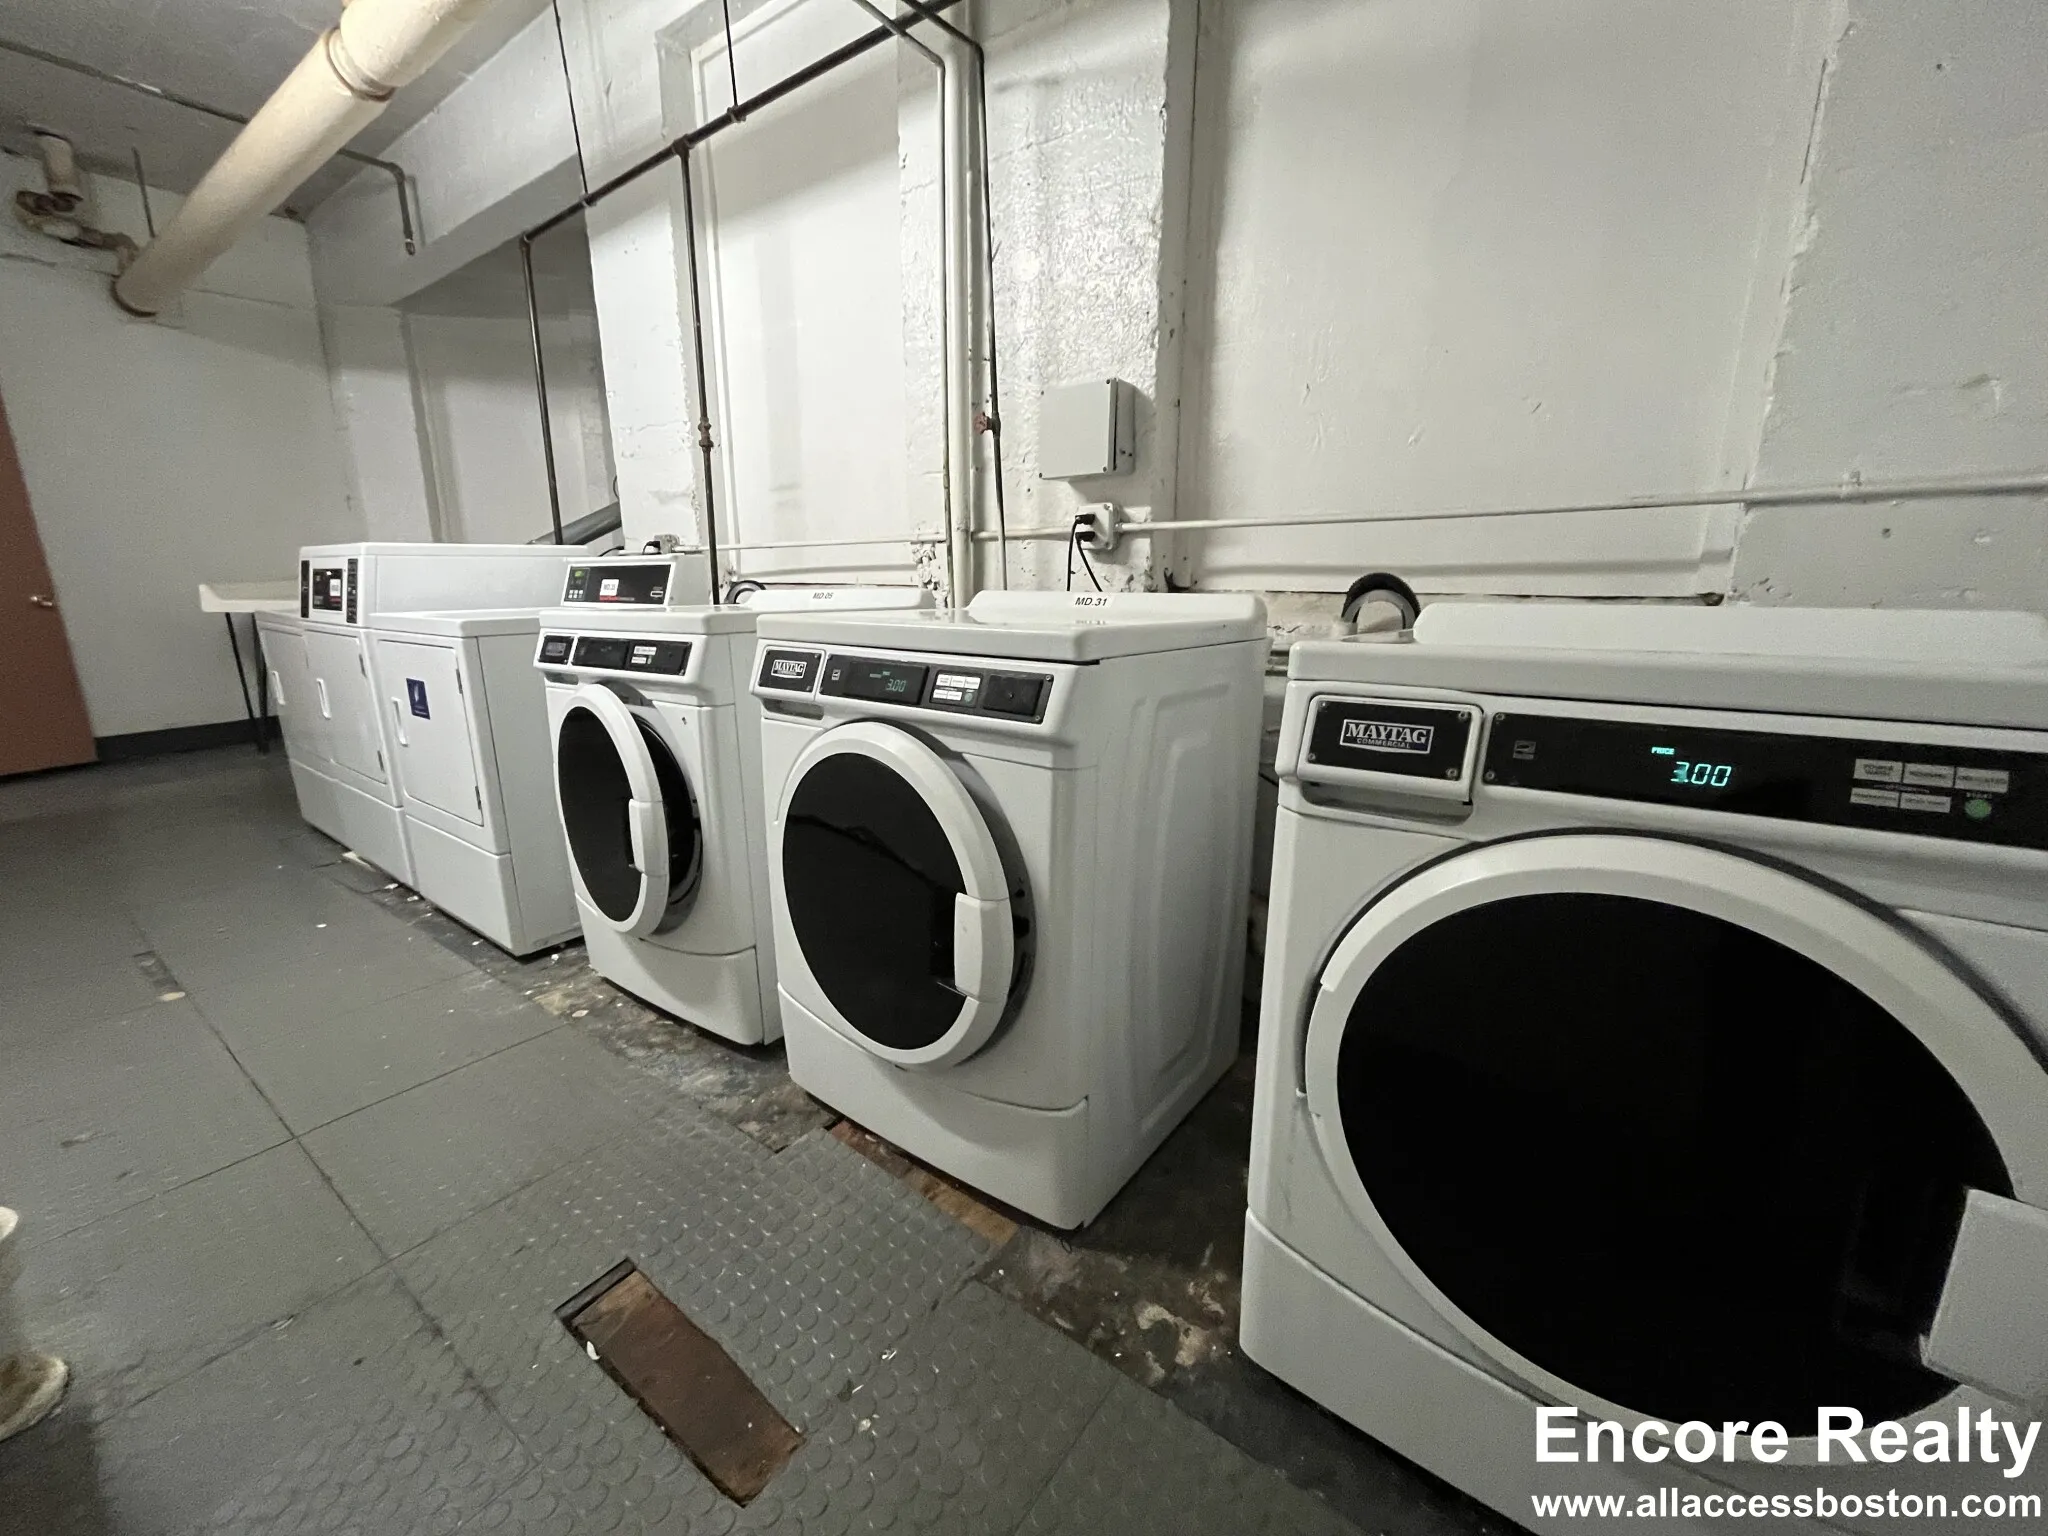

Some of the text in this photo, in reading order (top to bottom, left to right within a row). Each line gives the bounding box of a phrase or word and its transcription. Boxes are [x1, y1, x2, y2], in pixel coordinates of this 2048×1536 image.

[1075, 597, 1107, 606] MD.31
[885, 679, 907, 693] 3.00
[1345, 723, 1427, 744] MAYTAG
[1356, 738, 1411, 749] COMMERCIAL
[1651, 747, 1675, 755] PRICE
[1670, 761, 1732, 787] 3.00
